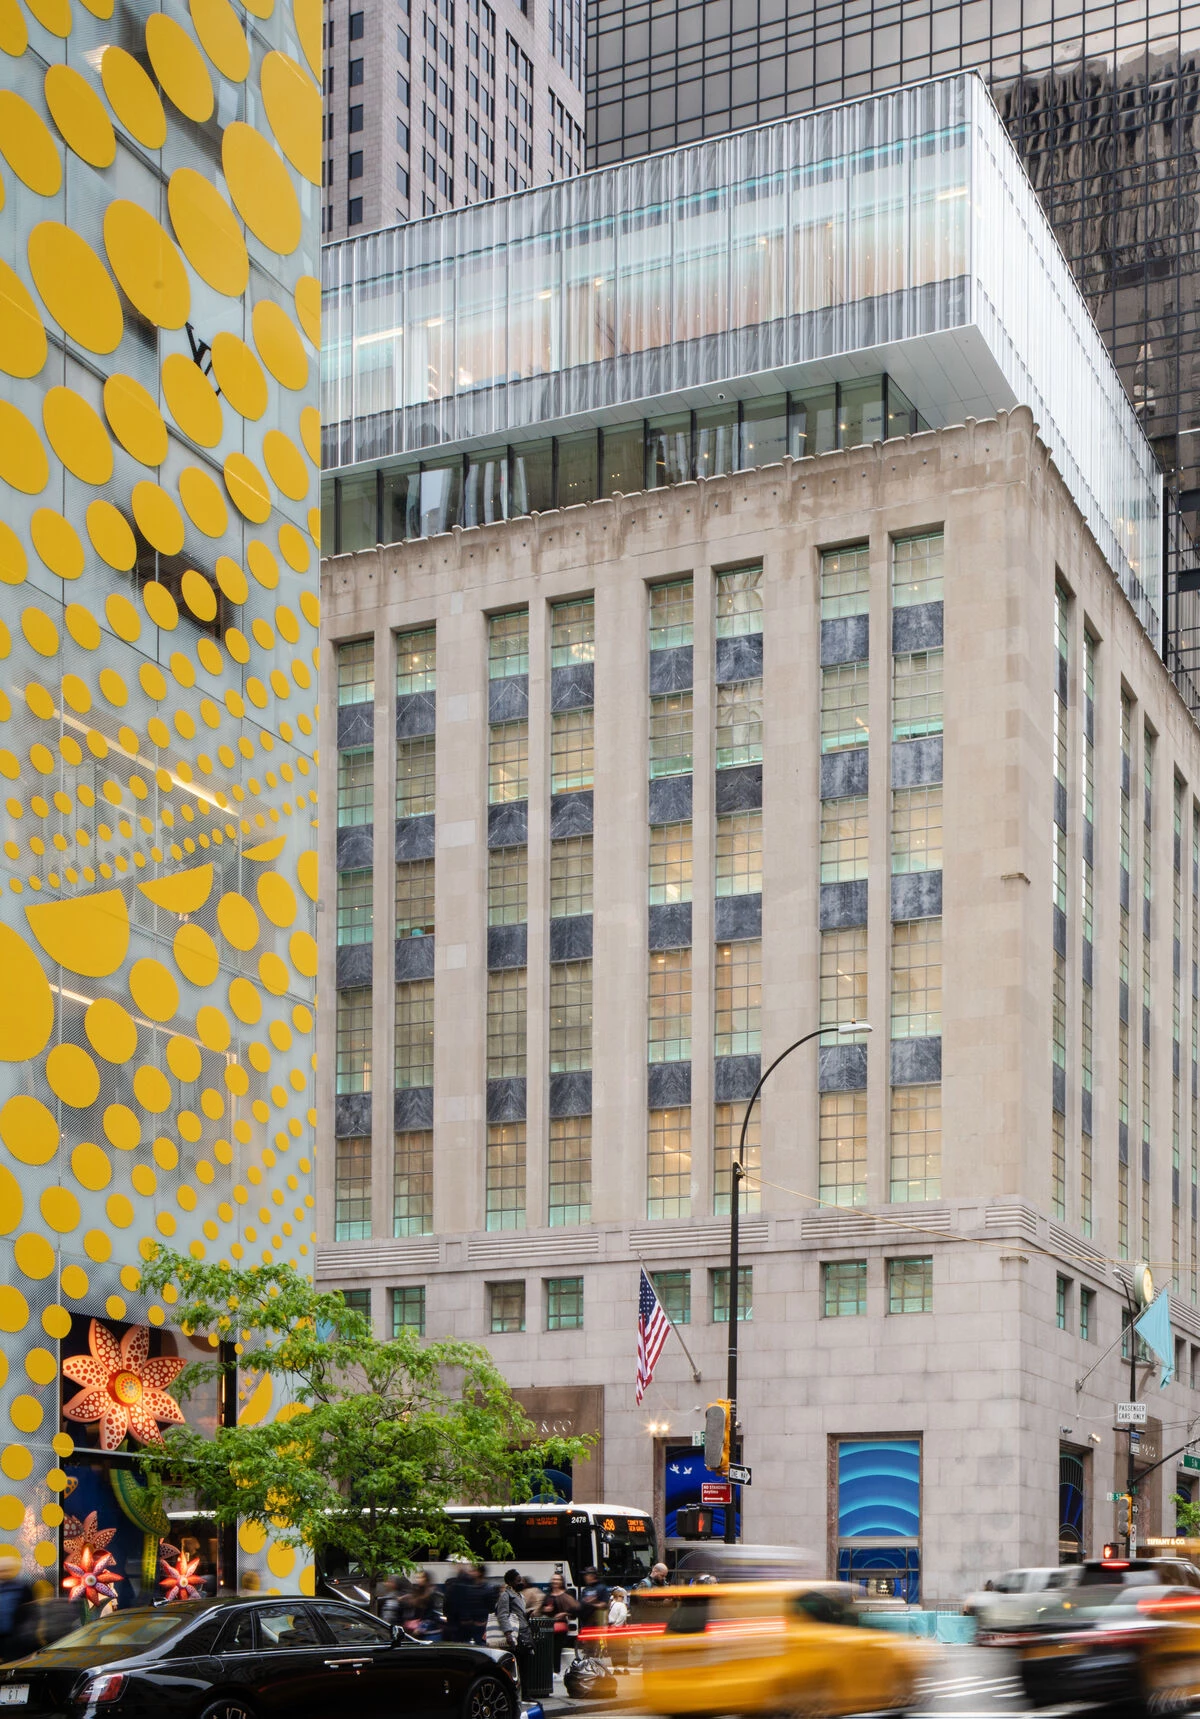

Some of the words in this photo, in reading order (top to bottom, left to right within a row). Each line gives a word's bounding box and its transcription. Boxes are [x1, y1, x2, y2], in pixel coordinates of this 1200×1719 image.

[1118, 1404, 1145, 1412] PASSENGER
[1118, 1412, 1131, 1420] CARS
[1132, 1412, 1145, 1420] ONLY
[541, 1420, 549, 1433] &
[571, 1516, 587, 1524] 2478
